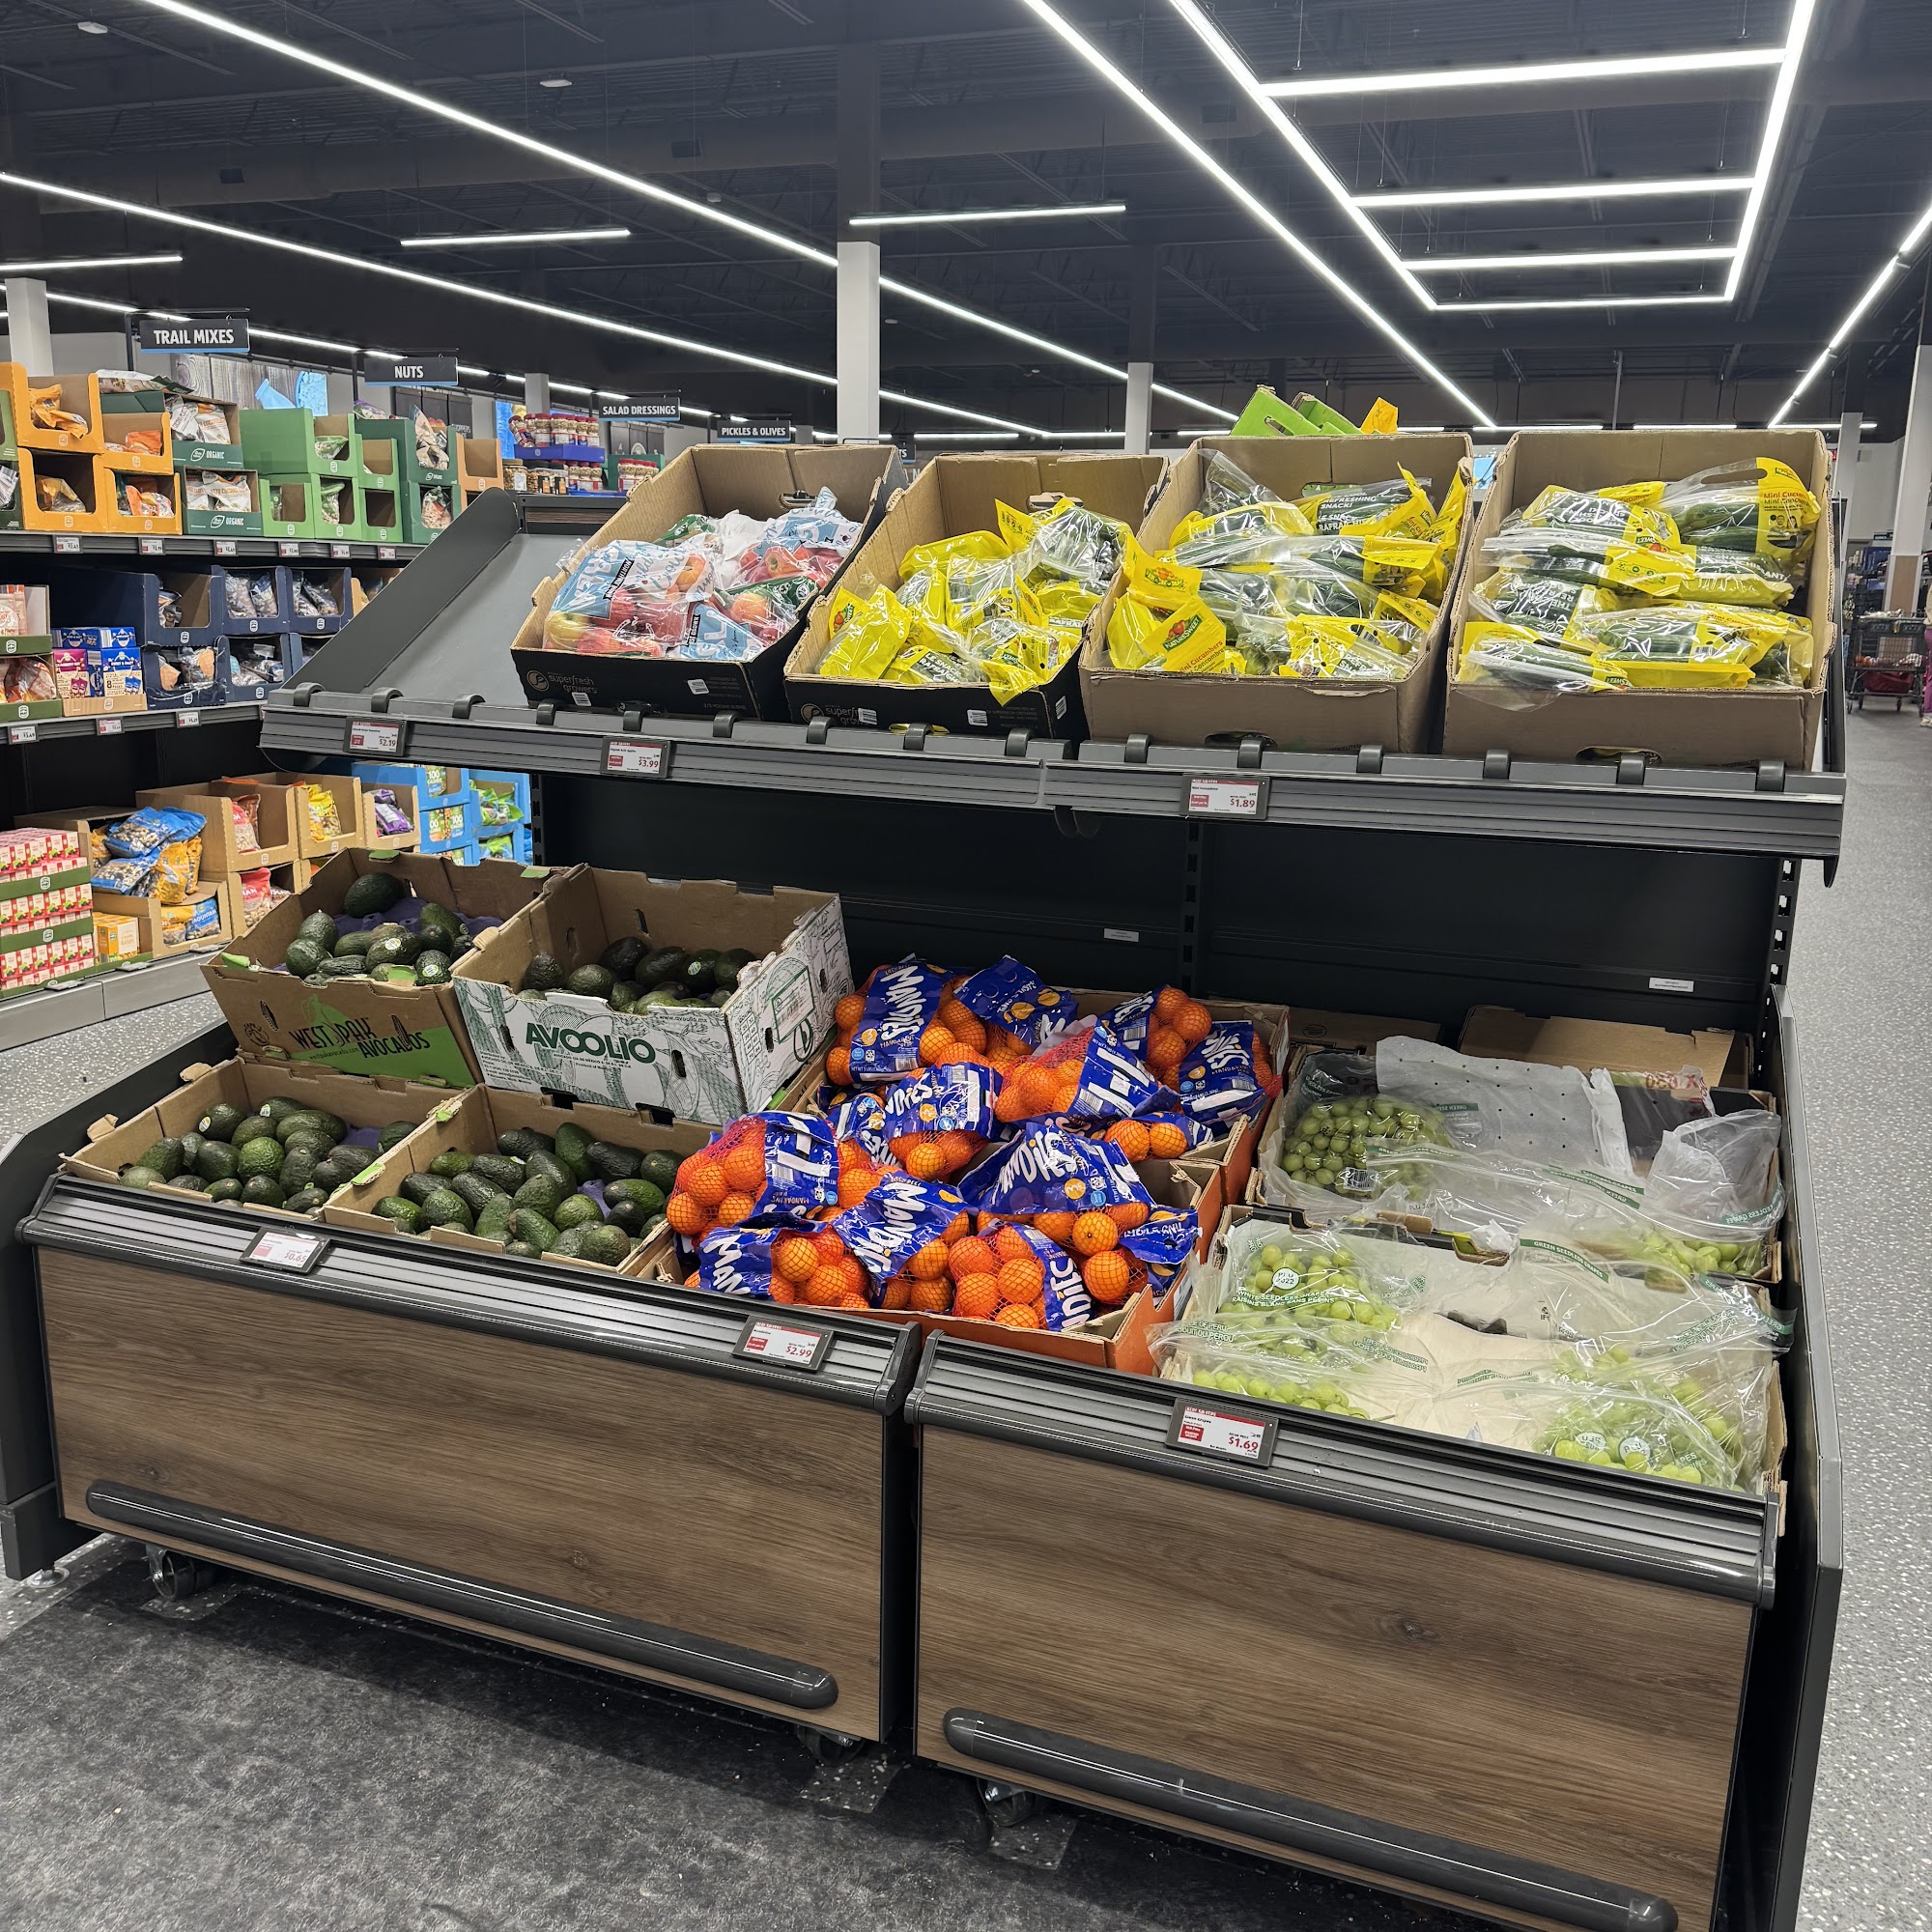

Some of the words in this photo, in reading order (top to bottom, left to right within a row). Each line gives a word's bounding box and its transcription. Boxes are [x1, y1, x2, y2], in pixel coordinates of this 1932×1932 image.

[154, 329, 191, 345] TRAIL
[193, 328, 235, 344] MIXES
[394, 365, 424, 379] NUTS
[602, 405, 629, 415] SALAD
[631, 405, 676, 415] DRESSINGS
[721, 427, 751, 437] PICKLES
[753, 427, 757, 436] &
[759, 426, 786, 436] OLIVES
[225, 517, 244, 526] ORGANIC
[1164, 616, 1200, 649] NATURESWEET
[1190, 640, 1223, 666] Cucumbers
[549, 674, 594, 686] superfresh
[562, 684, 597, 694] growers
[379, 738, 396, 747] $2.19
[639, 759, 659, 768] $3.99
[428, 770, 440, 780] 100
[1230, 798, 1255, 808] $1.89
[429, 820, 440, 829] 00
[288, 1025, 335, 1051] WEST
[334, 1017, 377, 1044] PAK
[526, 1022, 656, 1064] AVOOLIO
[284, 1251, 306, 1263] $0.65
[1534, 1240, 1555, 1251] GREEN
[1556, 1246, 1584, 1264] SEEDLESS
[1584, 1261, 1604, 1278] GRAPES
[785, 1346, 812, 1357] $2.99
[1228, 1436, 1259, 1451] $1.69
